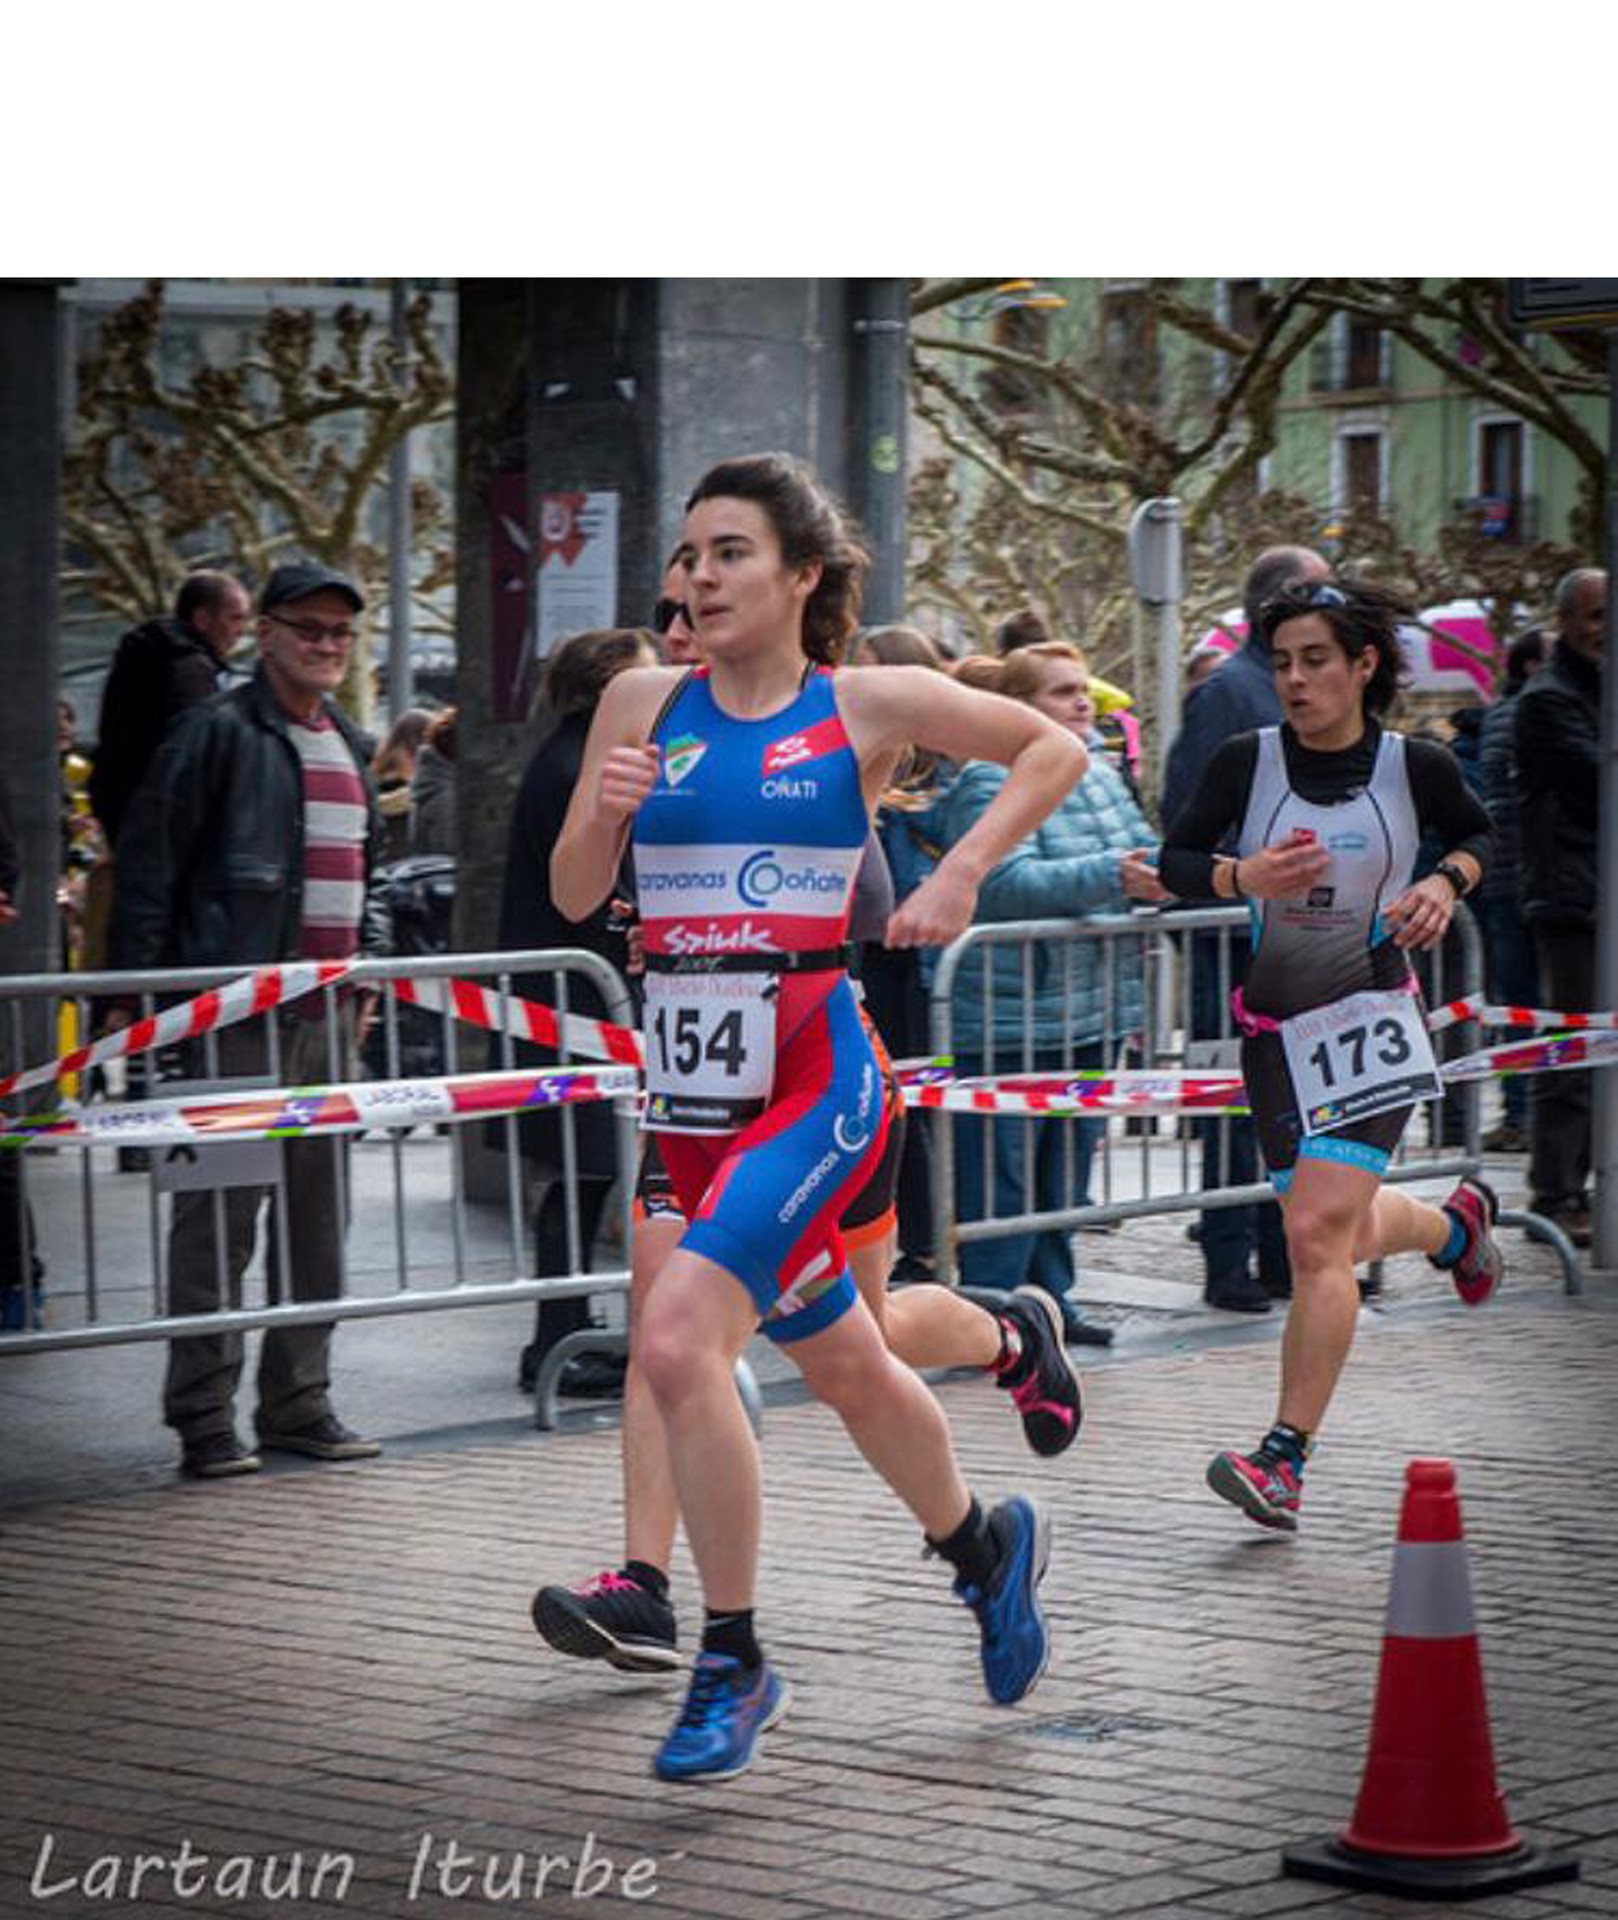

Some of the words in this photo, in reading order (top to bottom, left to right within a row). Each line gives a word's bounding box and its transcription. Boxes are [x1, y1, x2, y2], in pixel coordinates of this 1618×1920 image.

[638, 870, 727, 891] aravanas
[655, 1007, 746, 1076] 154
[1310, 1019, 1411, 1088] 173
